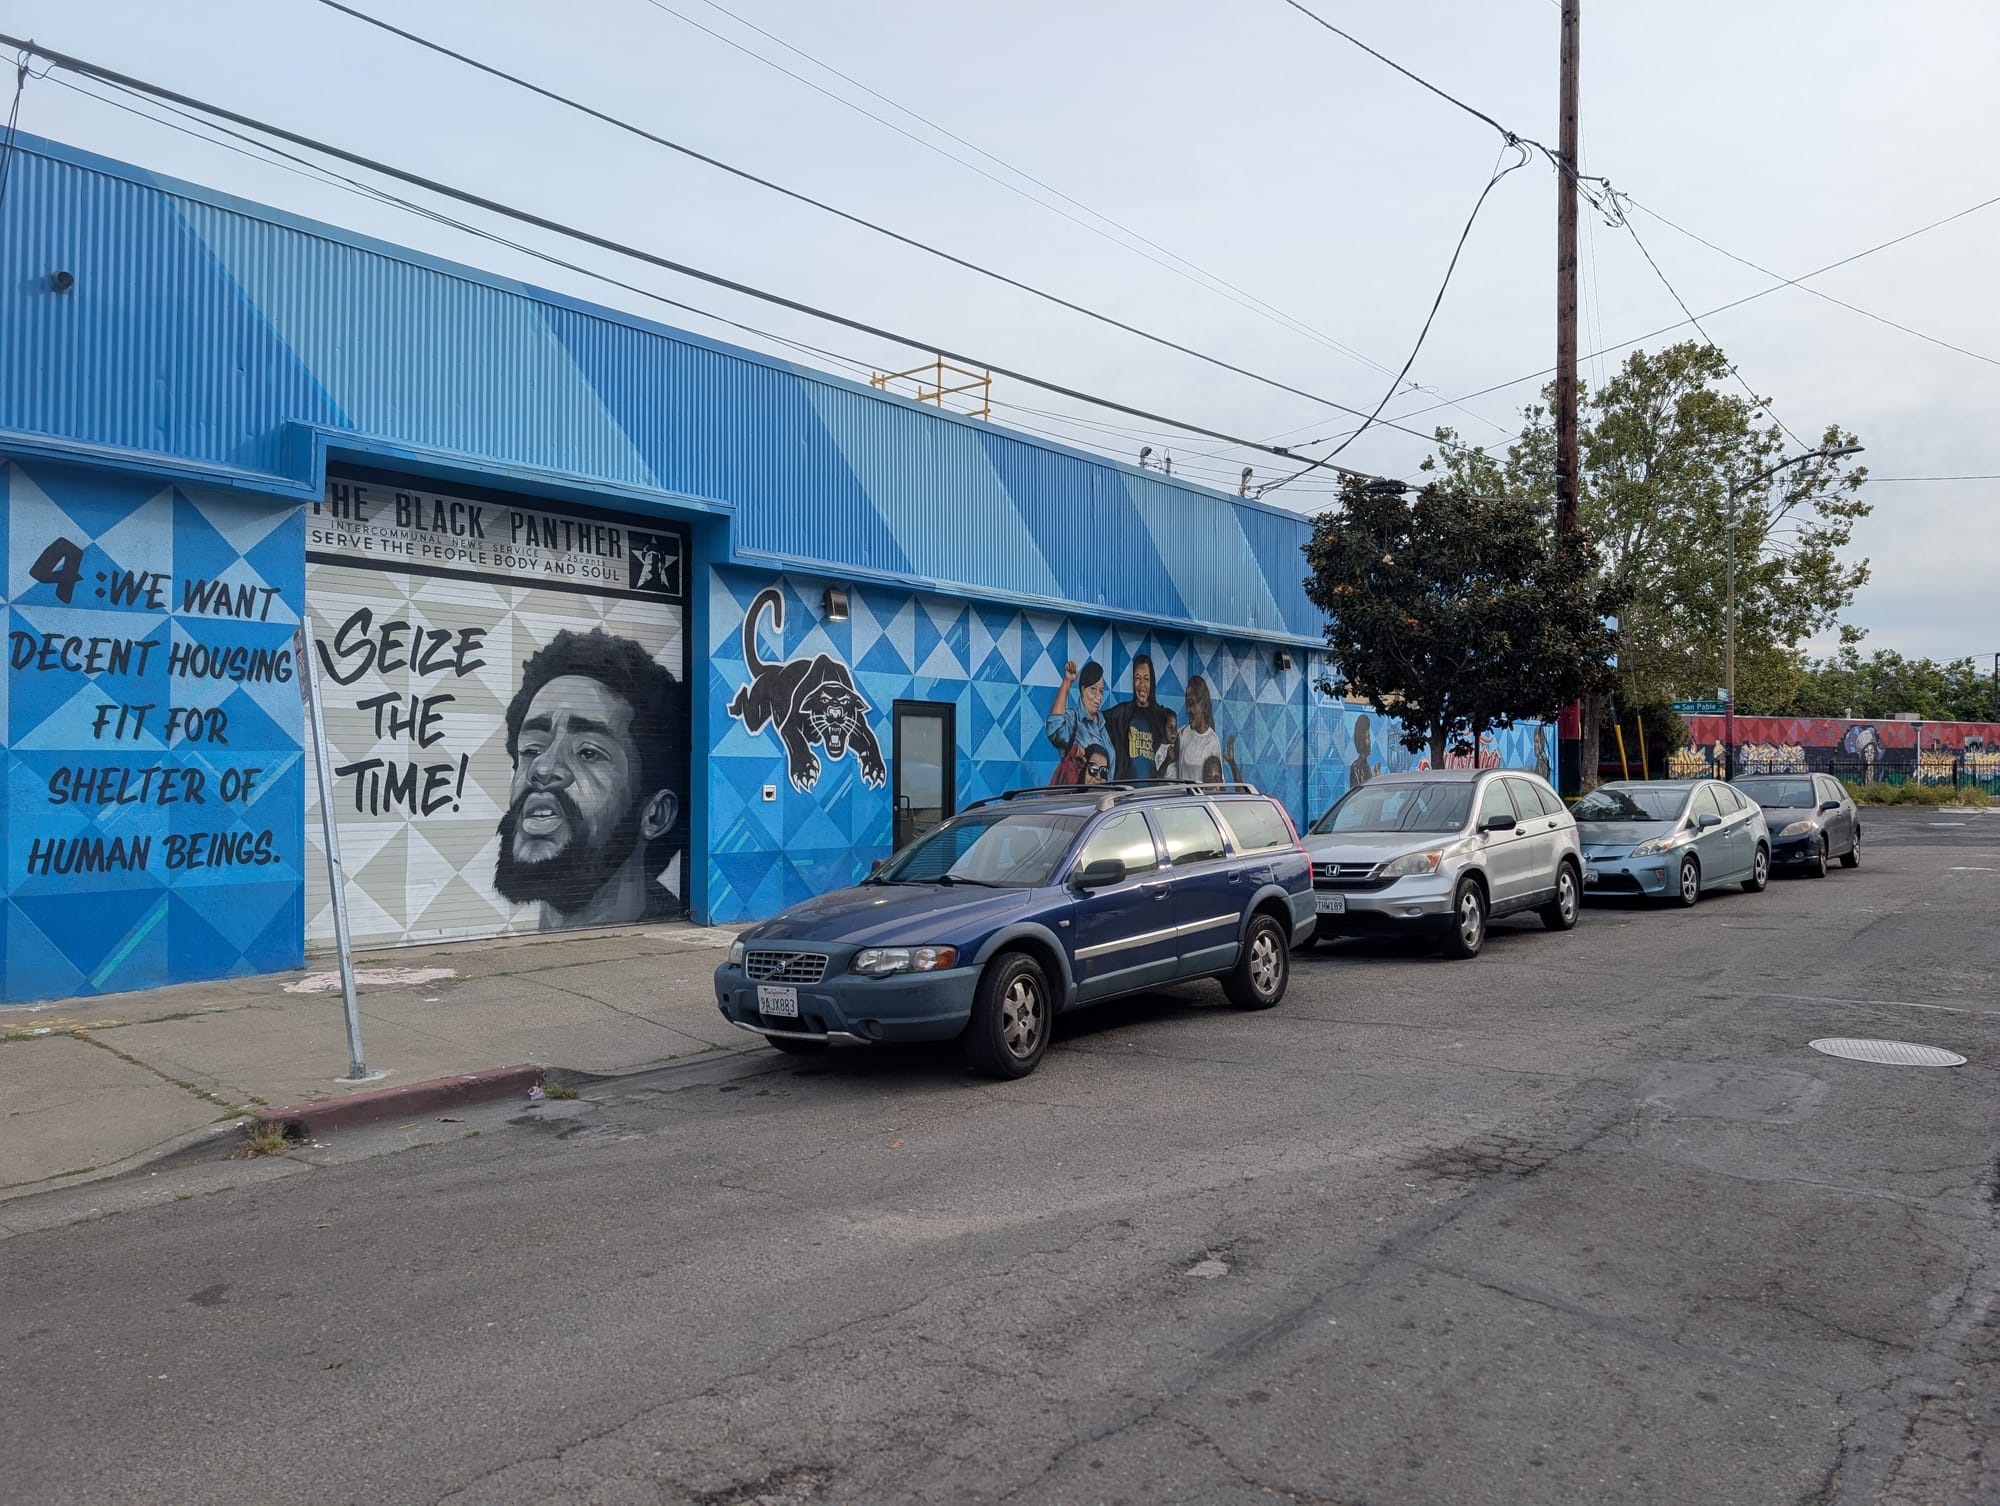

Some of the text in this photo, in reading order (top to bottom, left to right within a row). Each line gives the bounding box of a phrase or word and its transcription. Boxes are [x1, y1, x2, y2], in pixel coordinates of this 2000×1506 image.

[331, 520, 539, 558] INTERCOMMUNAL NEWS SERVICE
[395, 492, 485, 539] BLACK
[510, 511, 622, 560] PANTHER
[312, 530, 620, 582] SERVE THE PEOPLE BODY AND SOUL
[183, 579, 281, 622] WANT
[9, 630, 293, 684] DECENT HOUSING
[315, 606, 488, 686] SEIZE
[91, 704, 229, 745] FIT FOR
[356, 692, 456, 749] THE
[1682, 703, 1695, 711] San
[48, 767, 263, 805] SHELTER OF
[335, 752, 469, 817] TIME!
[27, 830, 281, 876] HUMAN BEINGS.
